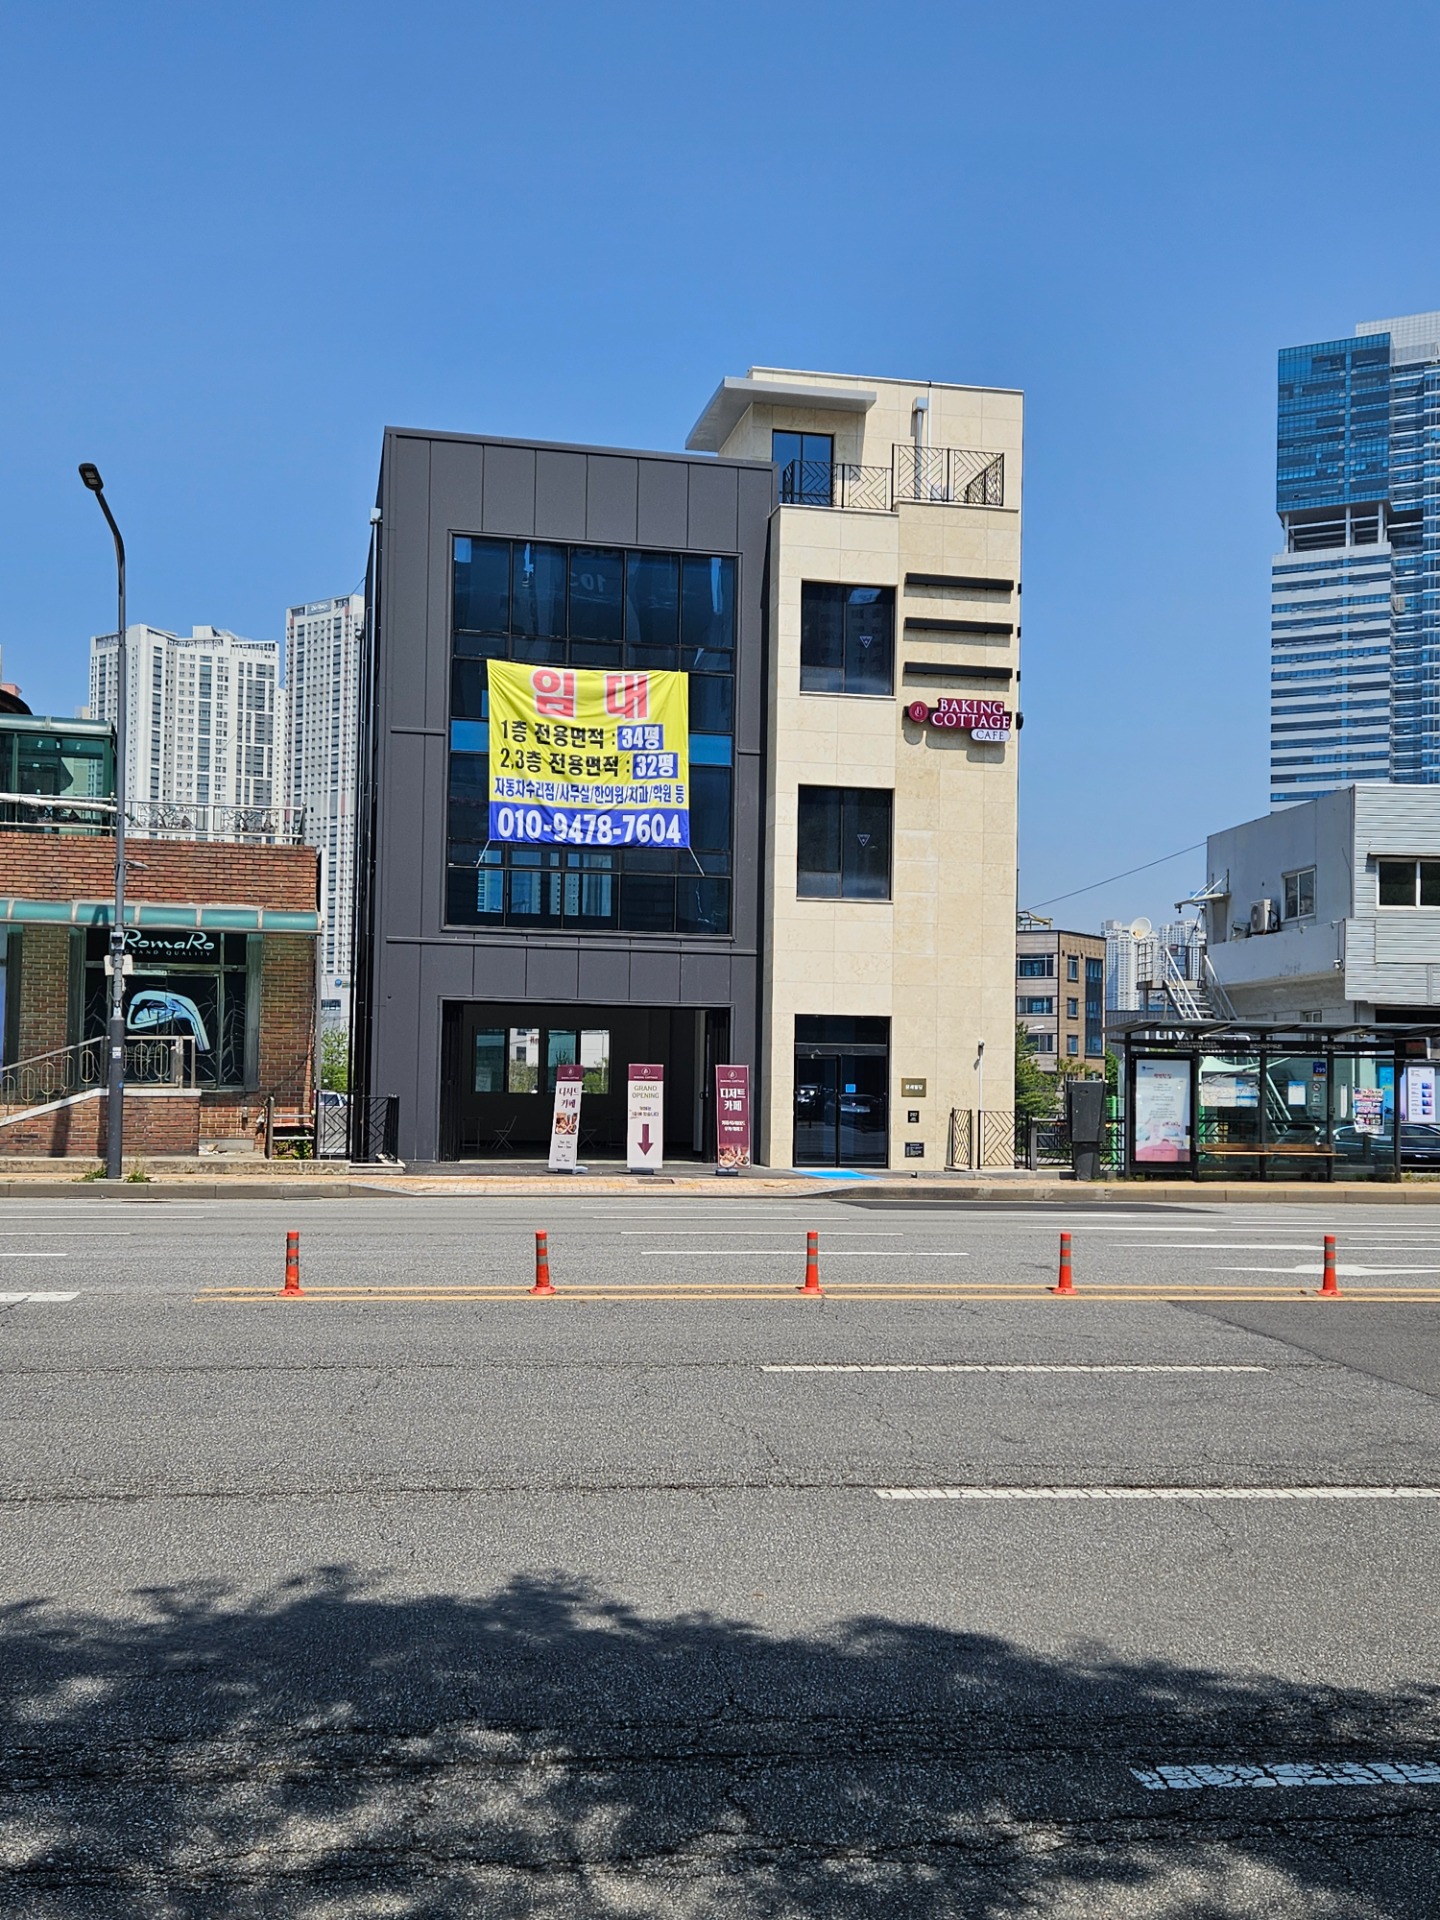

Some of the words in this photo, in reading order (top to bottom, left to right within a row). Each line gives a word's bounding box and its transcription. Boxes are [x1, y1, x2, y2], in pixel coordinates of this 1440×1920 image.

[940, 698, 1004, 715] BAKING
[932, 712, 1010, 729] COTTAGE
[501, 719, 527, 743] 1층
[534, 722, 604, 749] 전용면적
[621, 725, 660, 750] 34평
[975, 730, 1005, 740] CAFE
[500, 747, 542, 773] 2,3층
[549, 752, 619, 777] 전용면적
[635, 753, 674, 777] 32평
[675, 785, 685, 804] 등
[497, 807, 682, 844] 010-9478-7604
[122, 928, 215, 950] RomaRo
[720, 1088, 746, 1099] 디저트
[723, 1099, 742, 1111] 카페
